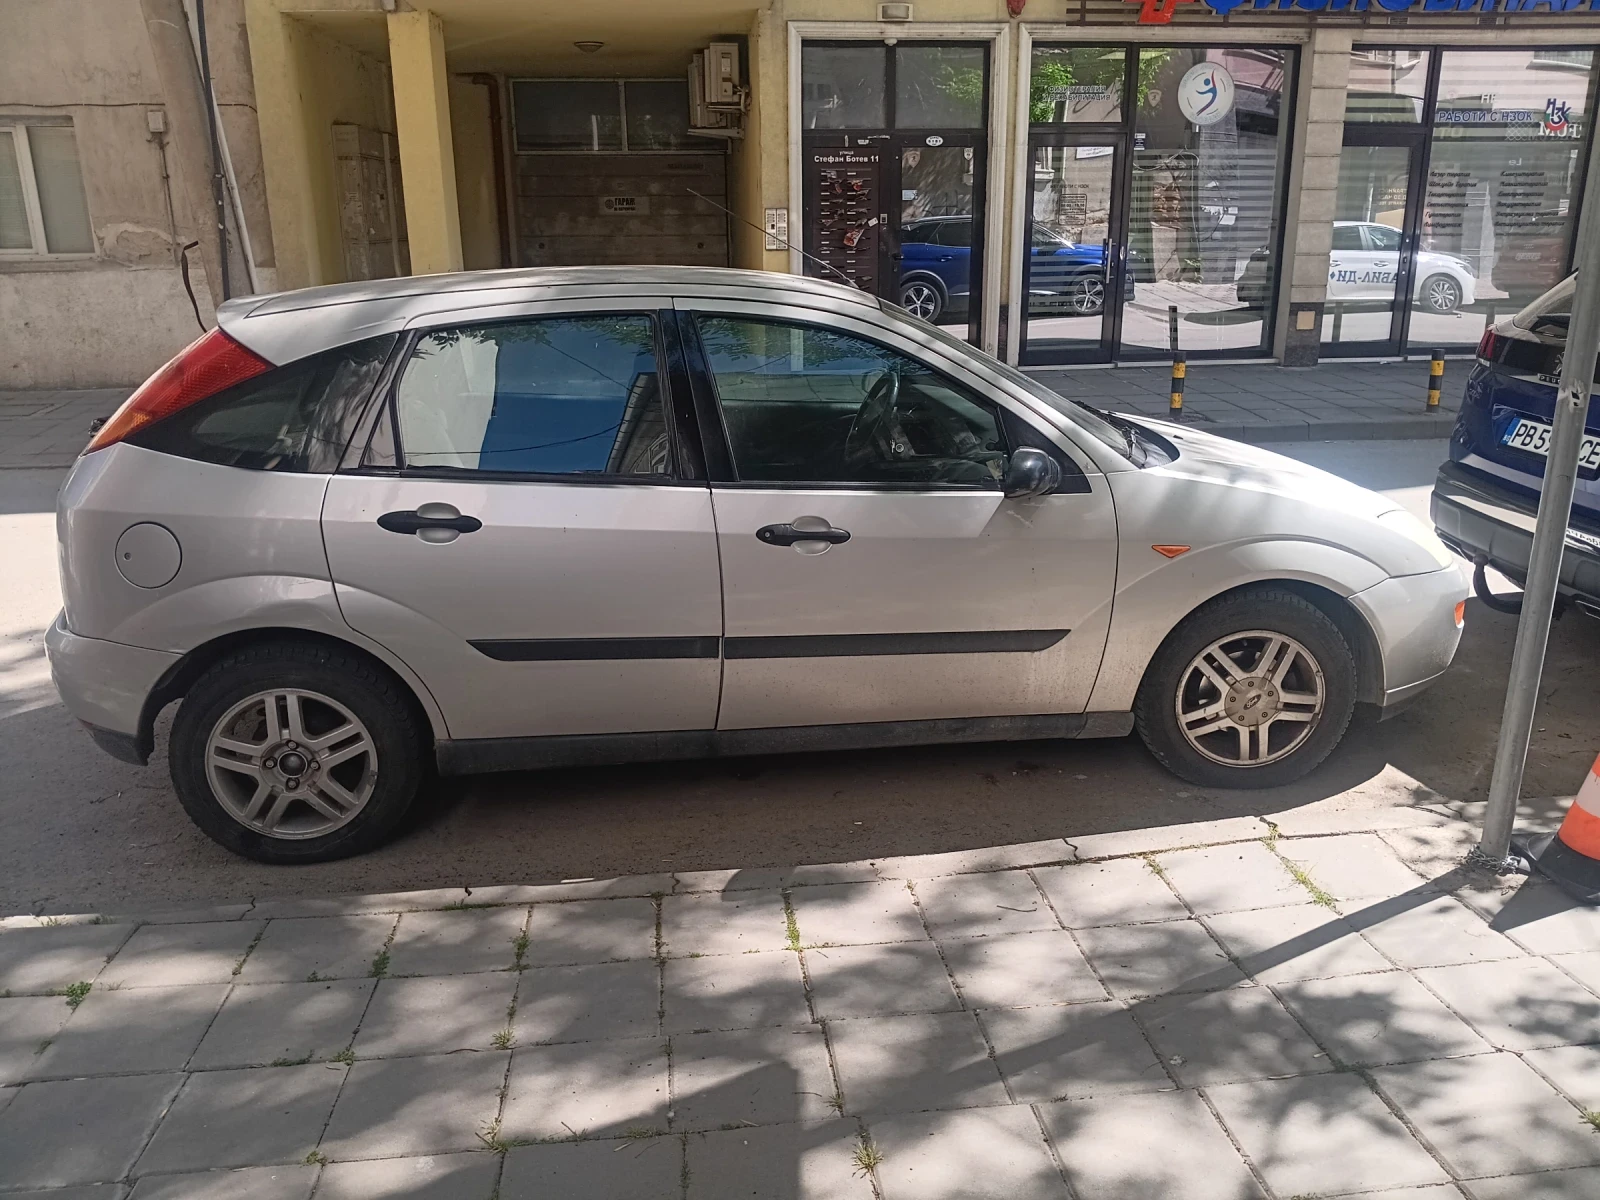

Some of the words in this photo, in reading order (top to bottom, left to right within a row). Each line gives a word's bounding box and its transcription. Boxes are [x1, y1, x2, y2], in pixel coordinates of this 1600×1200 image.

[1438, 111, 1487, 122] РАБОТИ
[1490, 111, 1498, 121] С
[1501, 110, 1534, 122] НЗОК
[814, 155, 844, 164] Стефан
[846, 155, 869, 163] Ботев
[870, 155, 879, 163] 11
